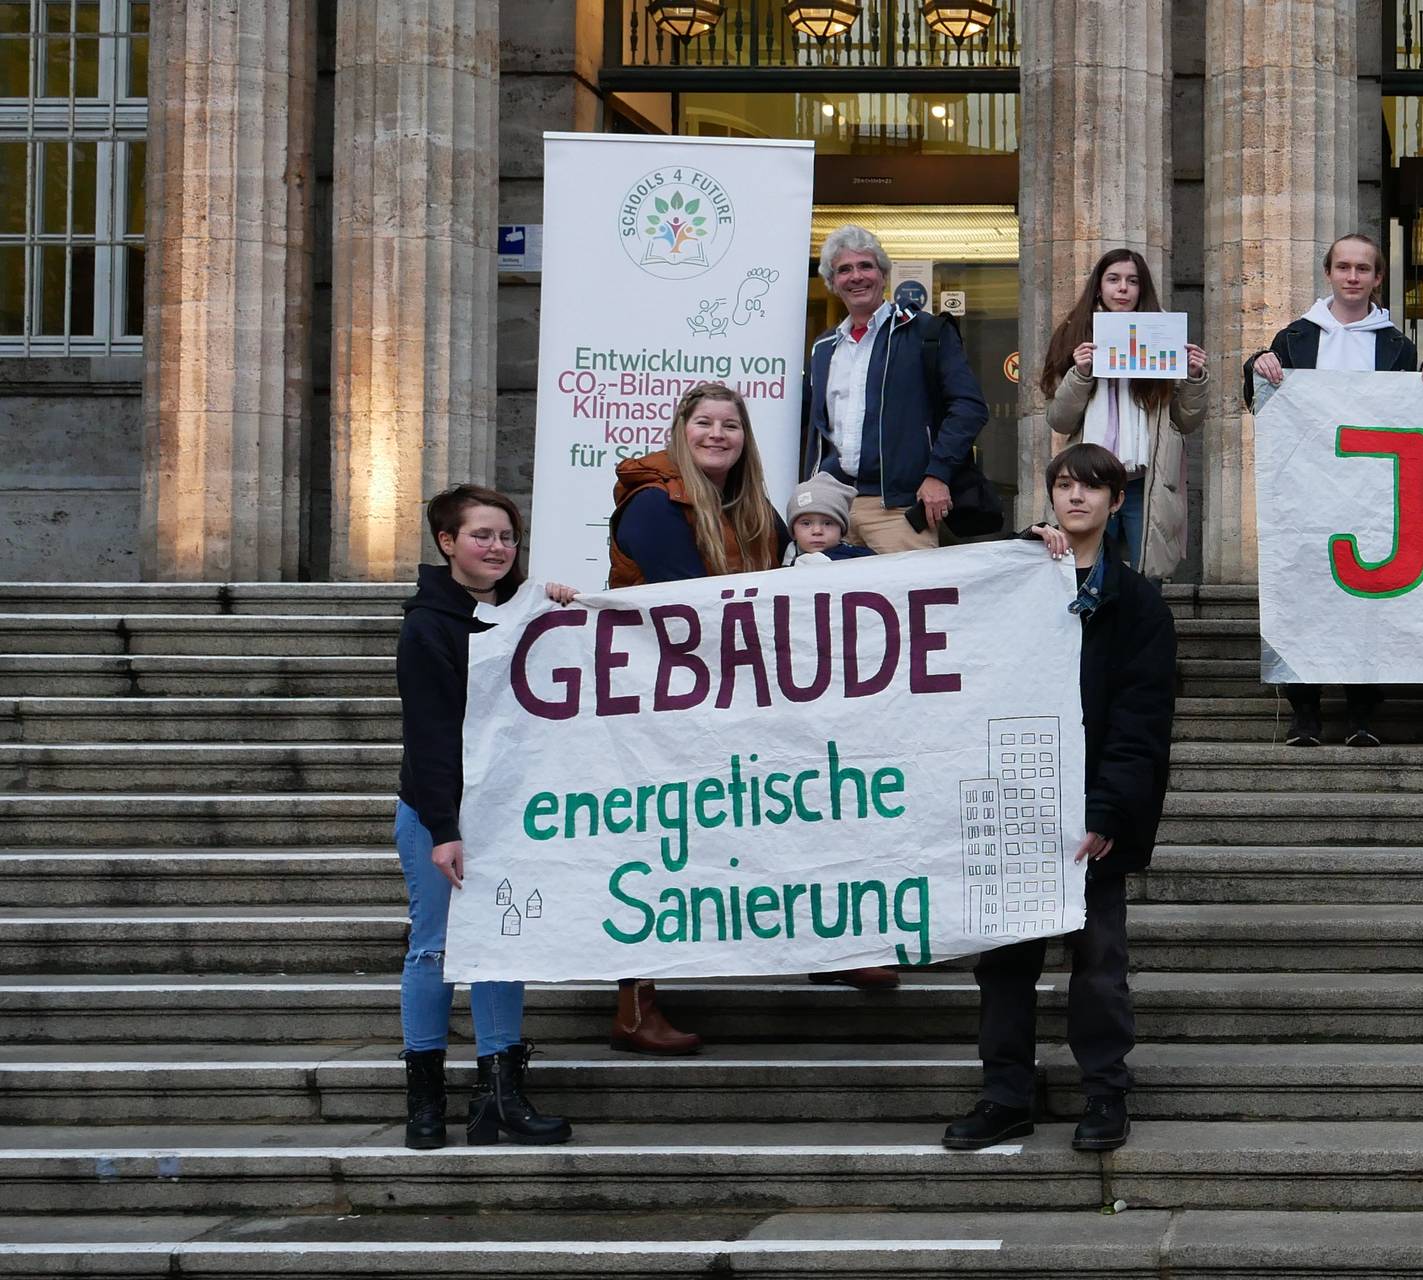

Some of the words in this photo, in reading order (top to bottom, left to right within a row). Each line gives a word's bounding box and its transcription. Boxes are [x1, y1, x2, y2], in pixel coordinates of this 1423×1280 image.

[622, 172, 664, 237] SCHOOLS
[673, 169, 682, 181] 4
[691, 173, 732, 225] FUTURE
[575, 346, 732, 378] Entwicklung
[740, 355, 786, 375] von
[738, 376, 785, 400] und
[570, 443, 607, 468] für
[510, 587, 962, 721] GEBÄUDE
[523, 741, 906, 872] energetische
[602, 857, 933, 968] Sanierung
